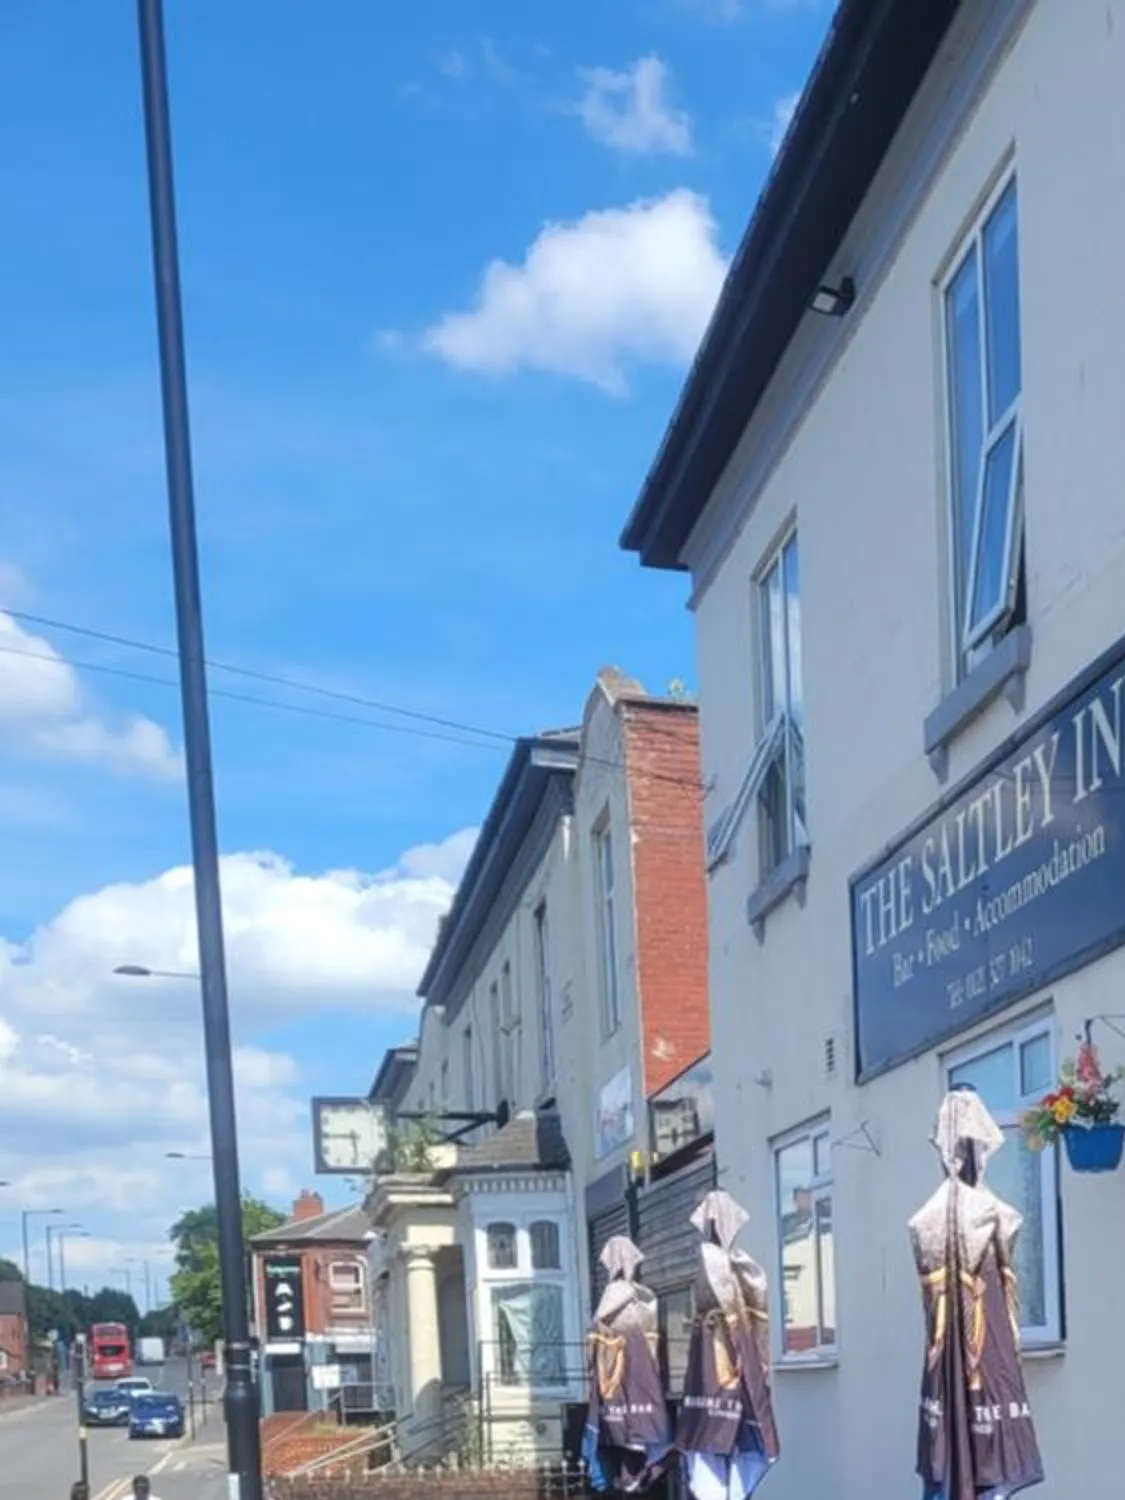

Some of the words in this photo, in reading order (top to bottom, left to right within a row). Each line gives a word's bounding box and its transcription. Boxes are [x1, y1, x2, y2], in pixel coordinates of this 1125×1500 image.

[861, 856, 913, 955] THE
[920, 732, 1060, 914] SALTLEY
[893, 953, 914, 989] Bar
[926, 910, 960, 965] Food
[973, 824, 1105, 937] Accommodation
